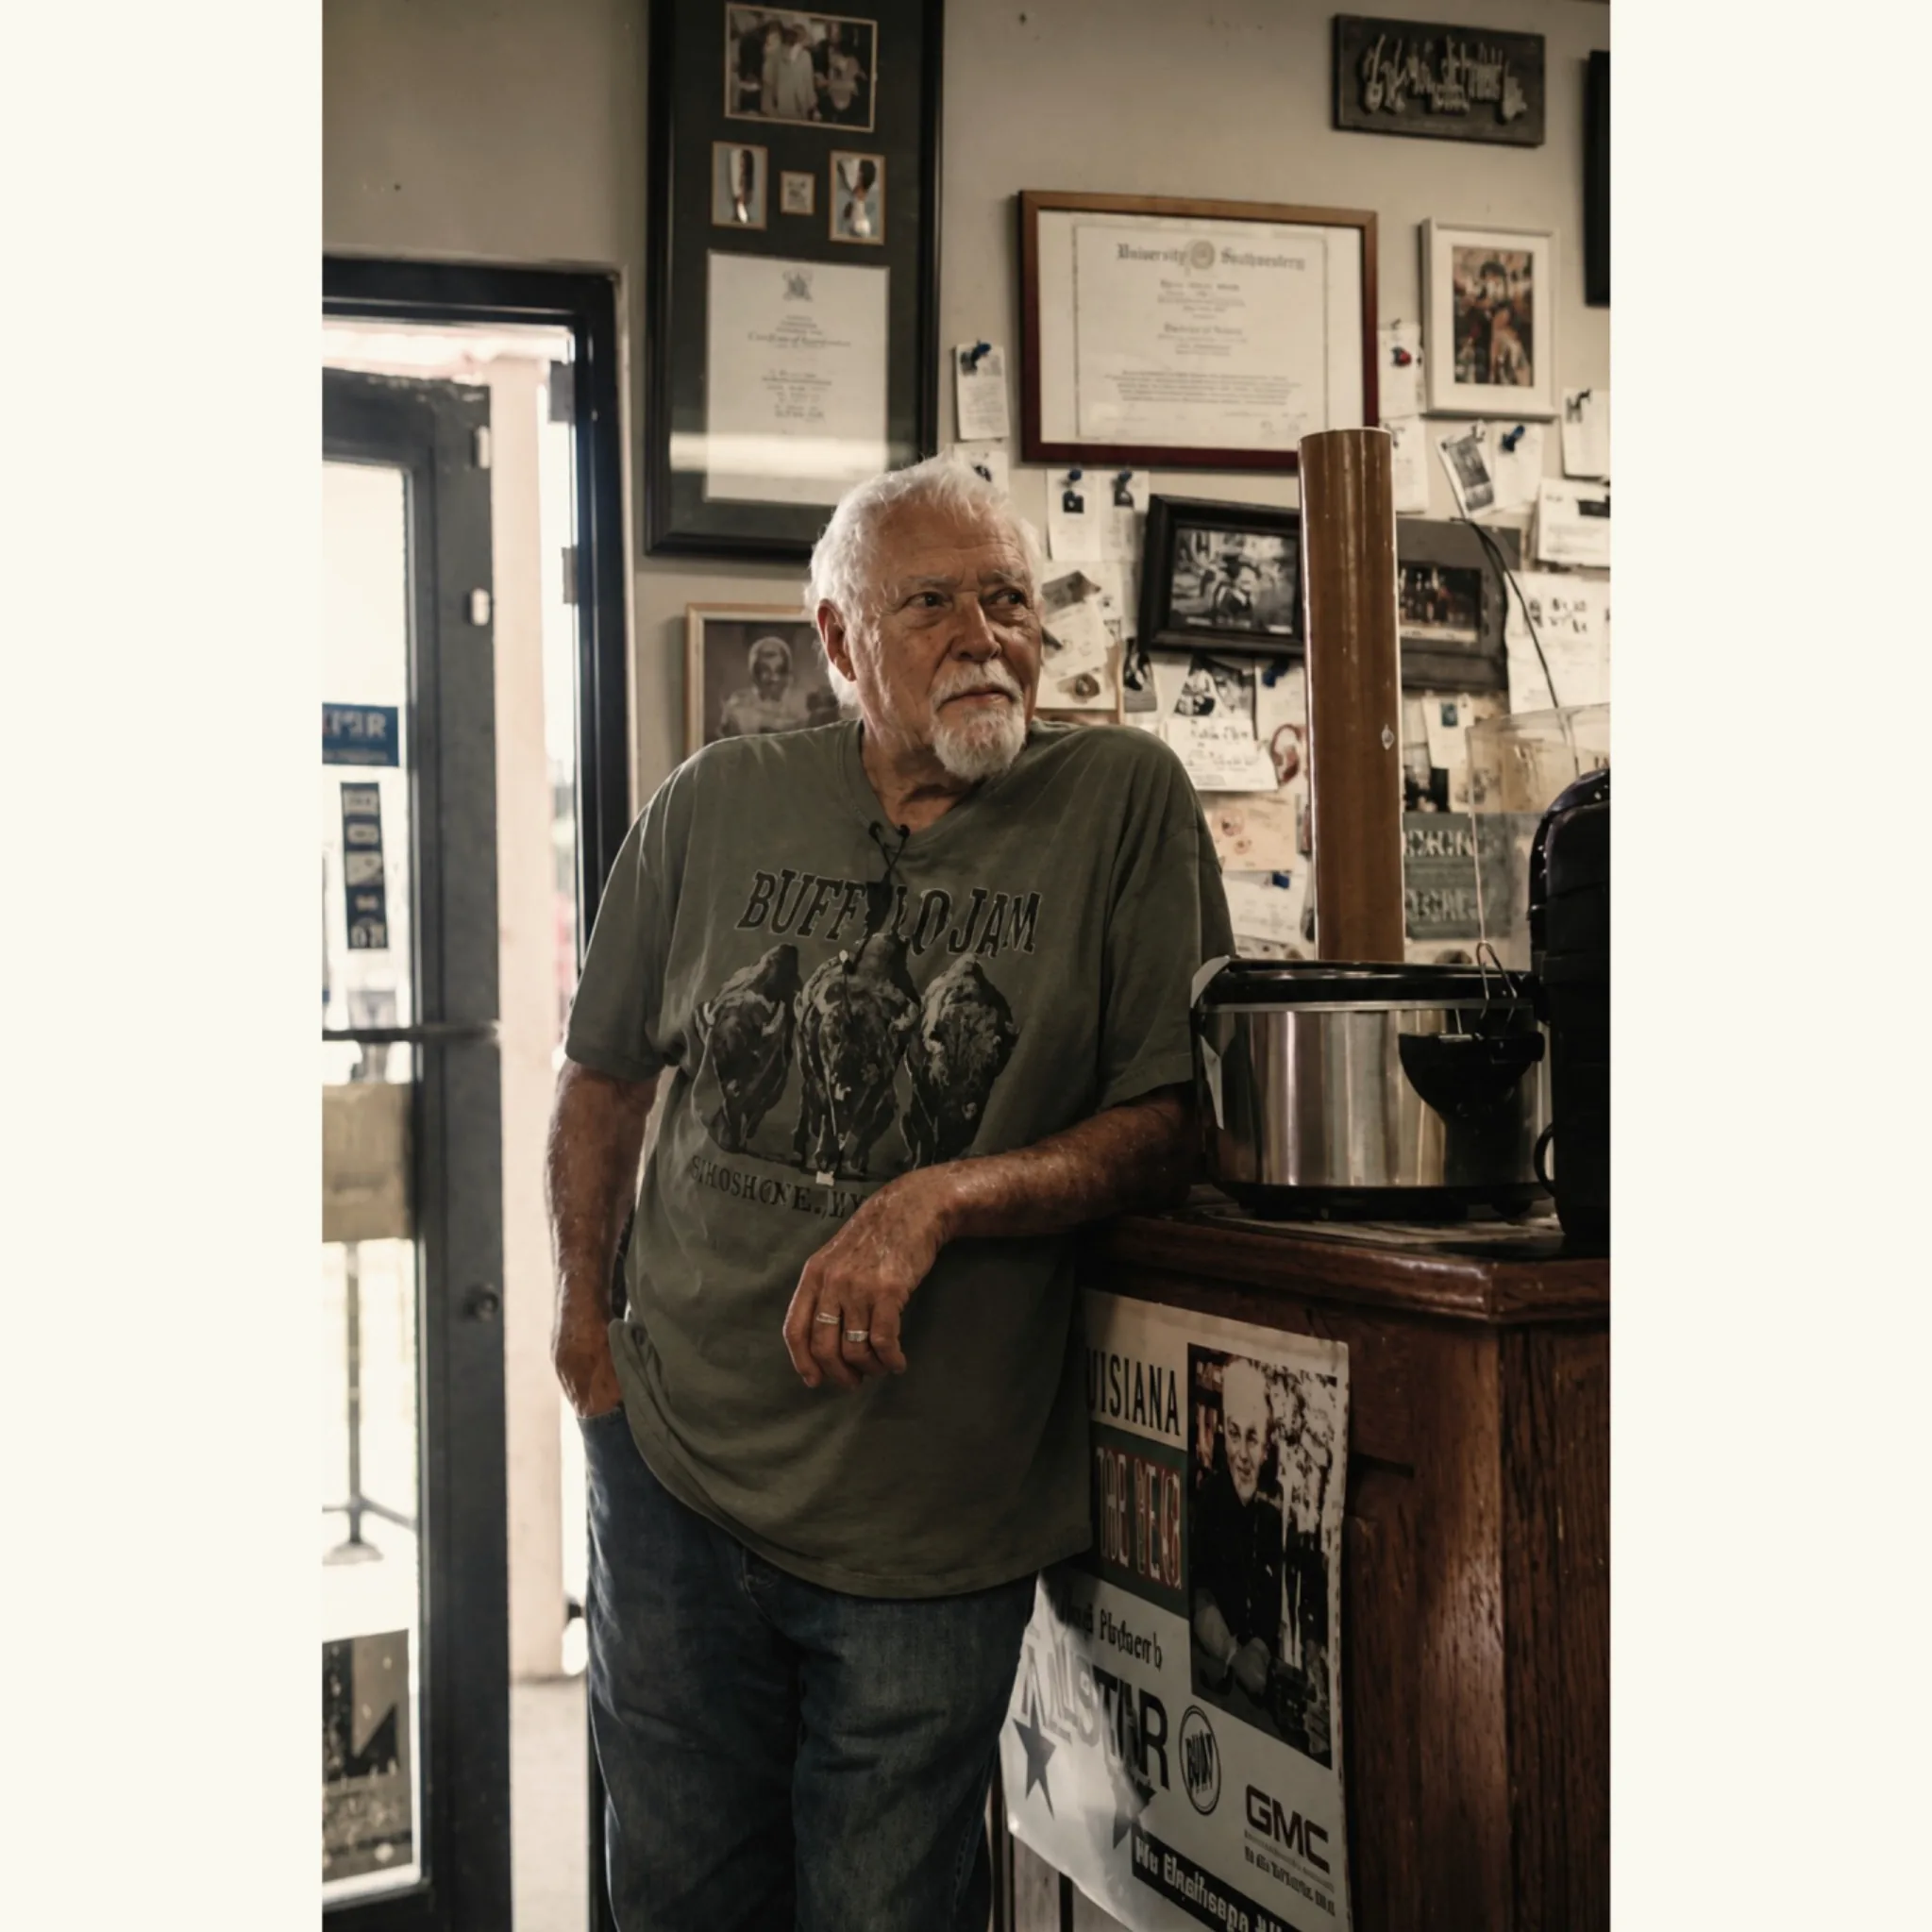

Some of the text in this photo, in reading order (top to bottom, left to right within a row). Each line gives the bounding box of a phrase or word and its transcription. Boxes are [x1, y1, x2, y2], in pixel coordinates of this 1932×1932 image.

[734, 867, 952, 956] BUFFLO
[1084, 1346, 1182, 1436] UISIANA
[1244, 1783, 1331, 1875] GMC
